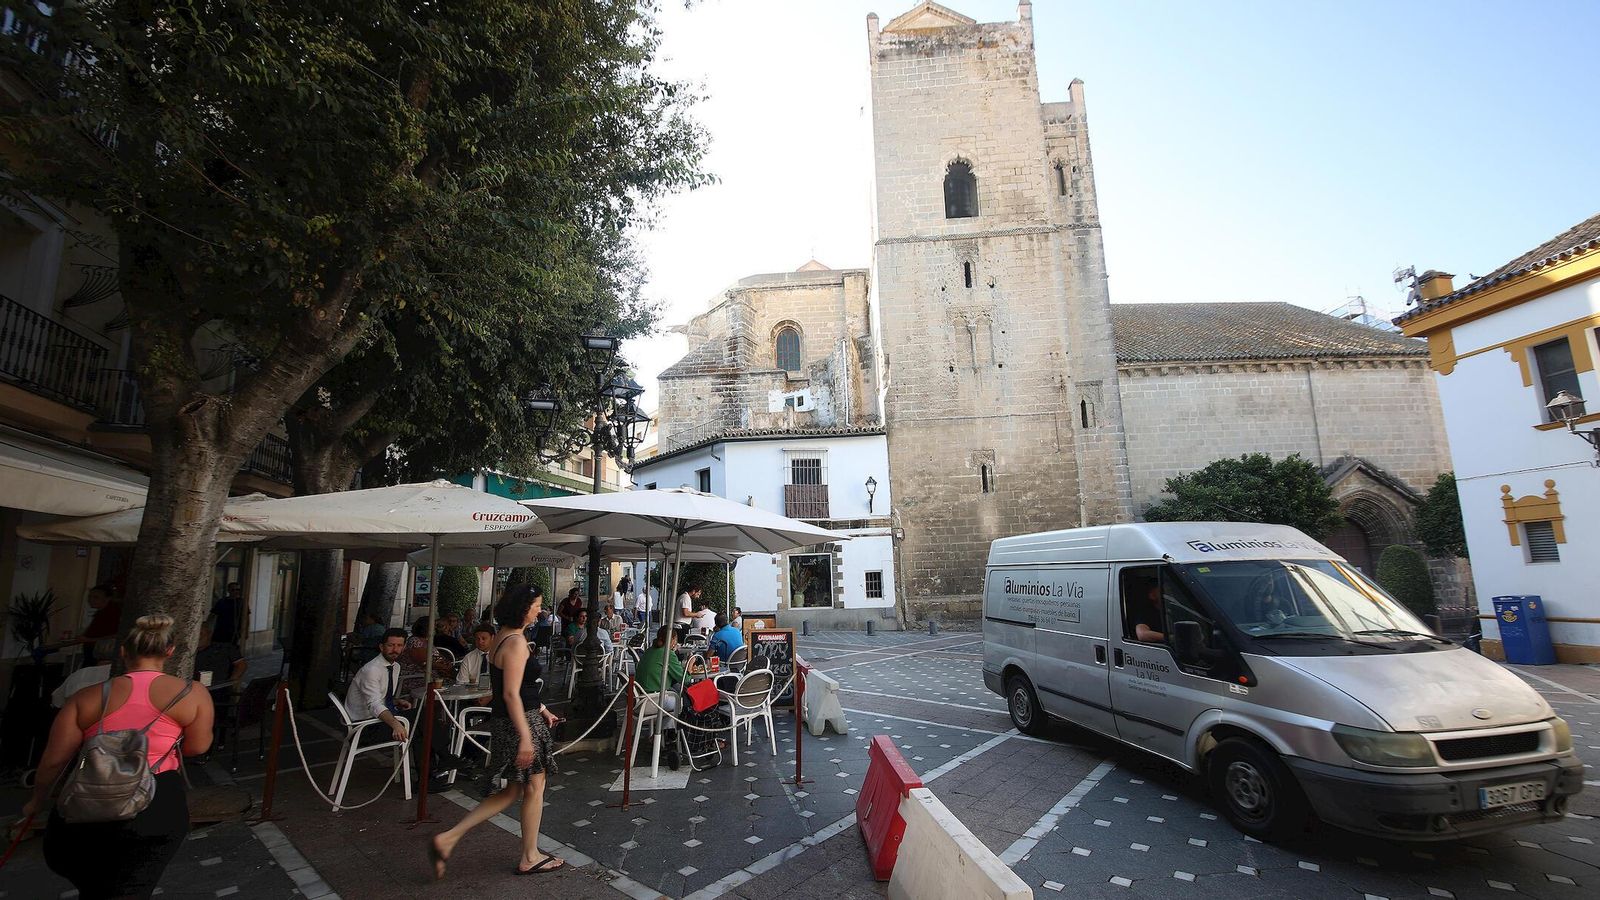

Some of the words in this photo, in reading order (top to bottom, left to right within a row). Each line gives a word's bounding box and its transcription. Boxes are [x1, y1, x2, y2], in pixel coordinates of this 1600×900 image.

[1195, 539, 1281, 553] aluminios
[1005, 579, 1051, 597] aluminios
[1052, 581, 1063, 597] La
[1126, 655, 1170, 673] aluminios
[1136, 669, 1146, 680] La
